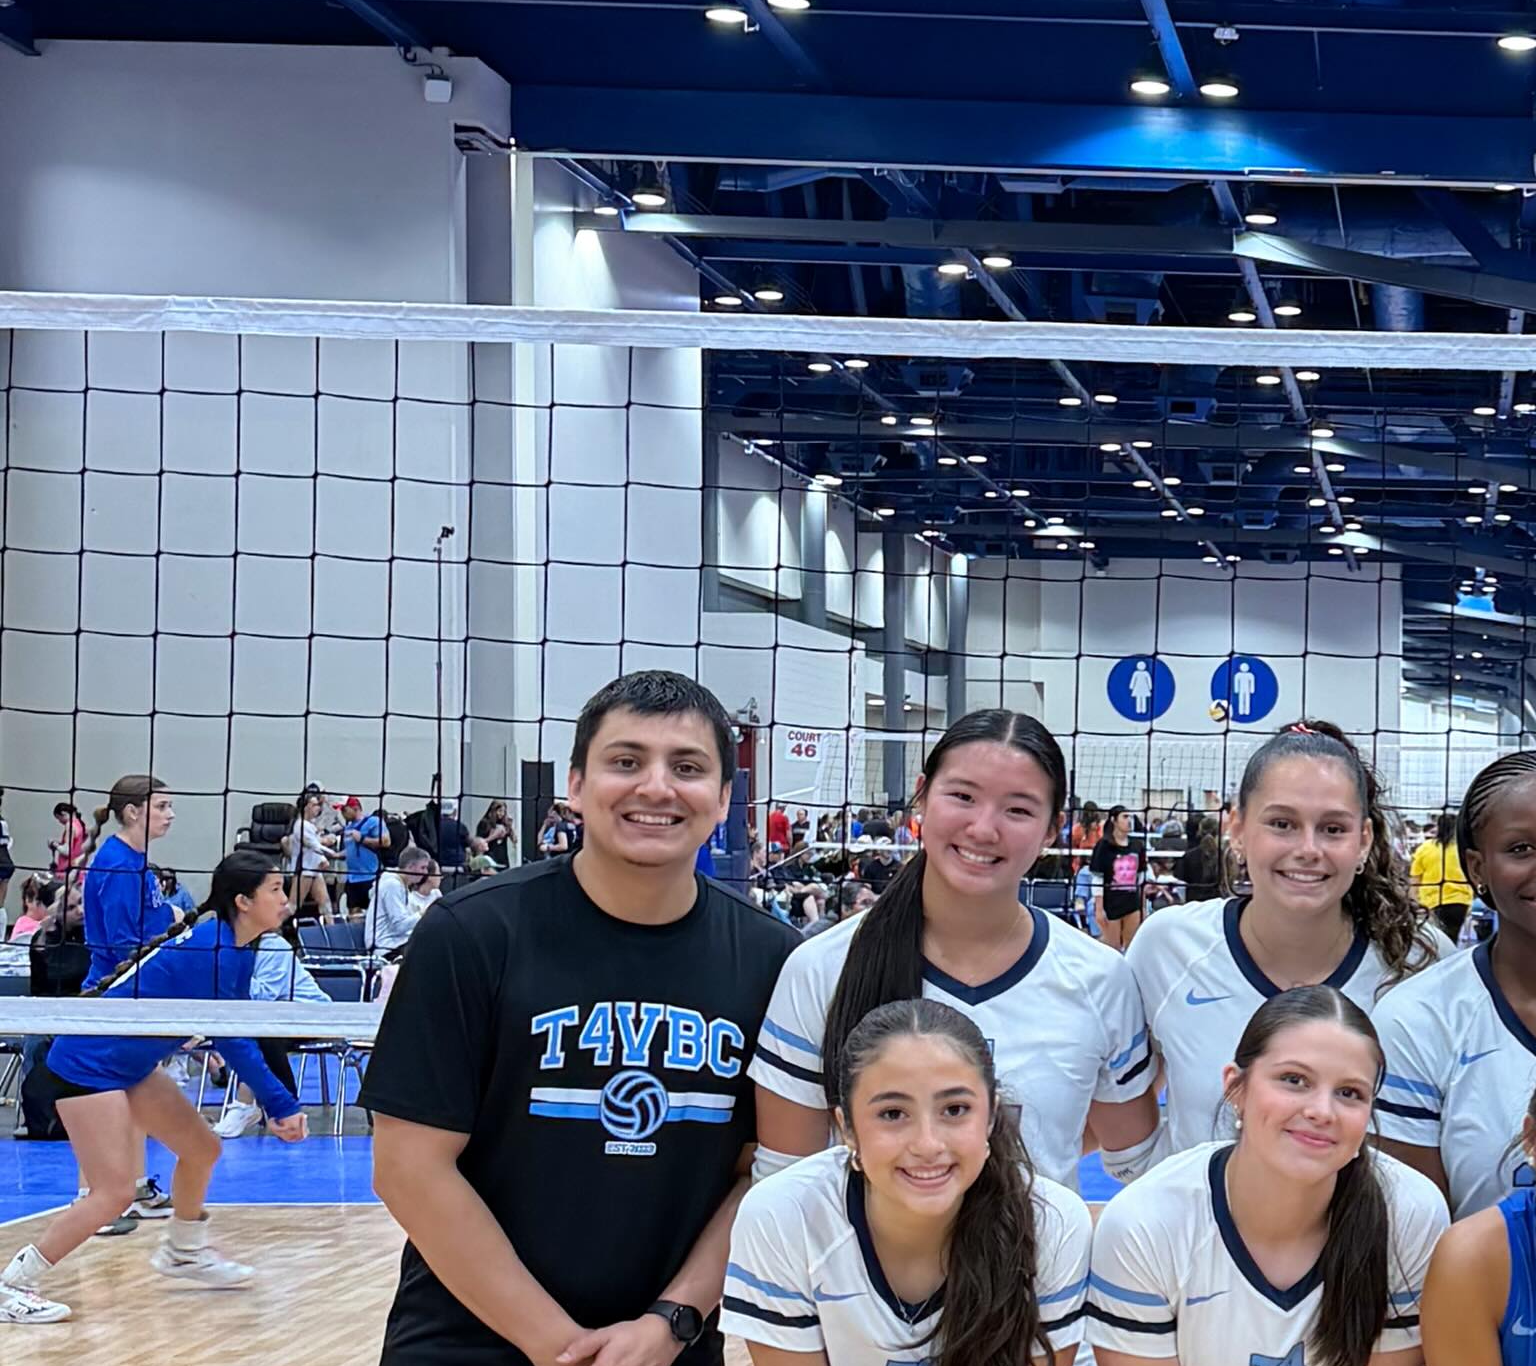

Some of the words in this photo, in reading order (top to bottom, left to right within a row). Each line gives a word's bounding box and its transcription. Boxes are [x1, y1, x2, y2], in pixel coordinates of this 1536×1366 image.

[787, 730, 821, 743] COURT
[790, 742, 817, 758] 46
[531, 1001, 745, 1079] T4VBC
